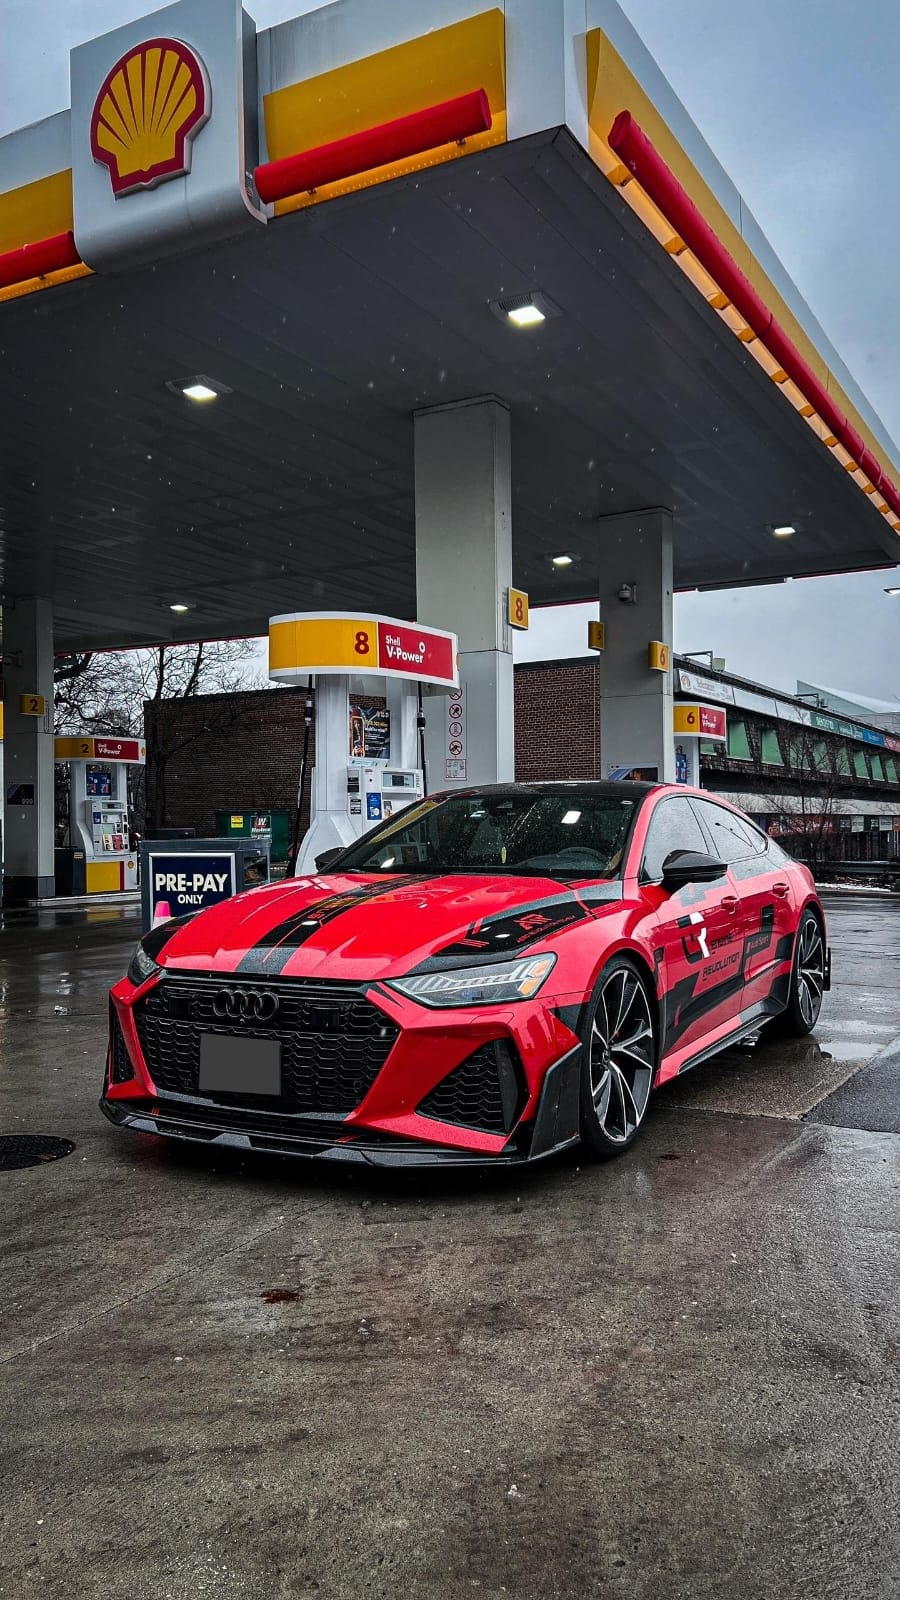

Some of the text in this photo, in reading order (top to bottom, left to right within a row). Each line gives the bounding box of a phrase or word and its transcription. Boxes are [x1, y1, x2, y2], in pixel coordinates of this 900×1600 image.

[515, 597, 523, 622] 8
[354, 631, 370, 655] 8
[385, 635, 401, 646] Shell
[386, 645, 424, 663] V-Power
[659, 648, 666, 666] 6
[29, 698, 38, 712] 2
[686, 711, 695, 725] 6
[80, 743, 89, 754] 2
[155, 873, 229, 892] PRE-PAY
[177, 894, 204, 904] ONLY
